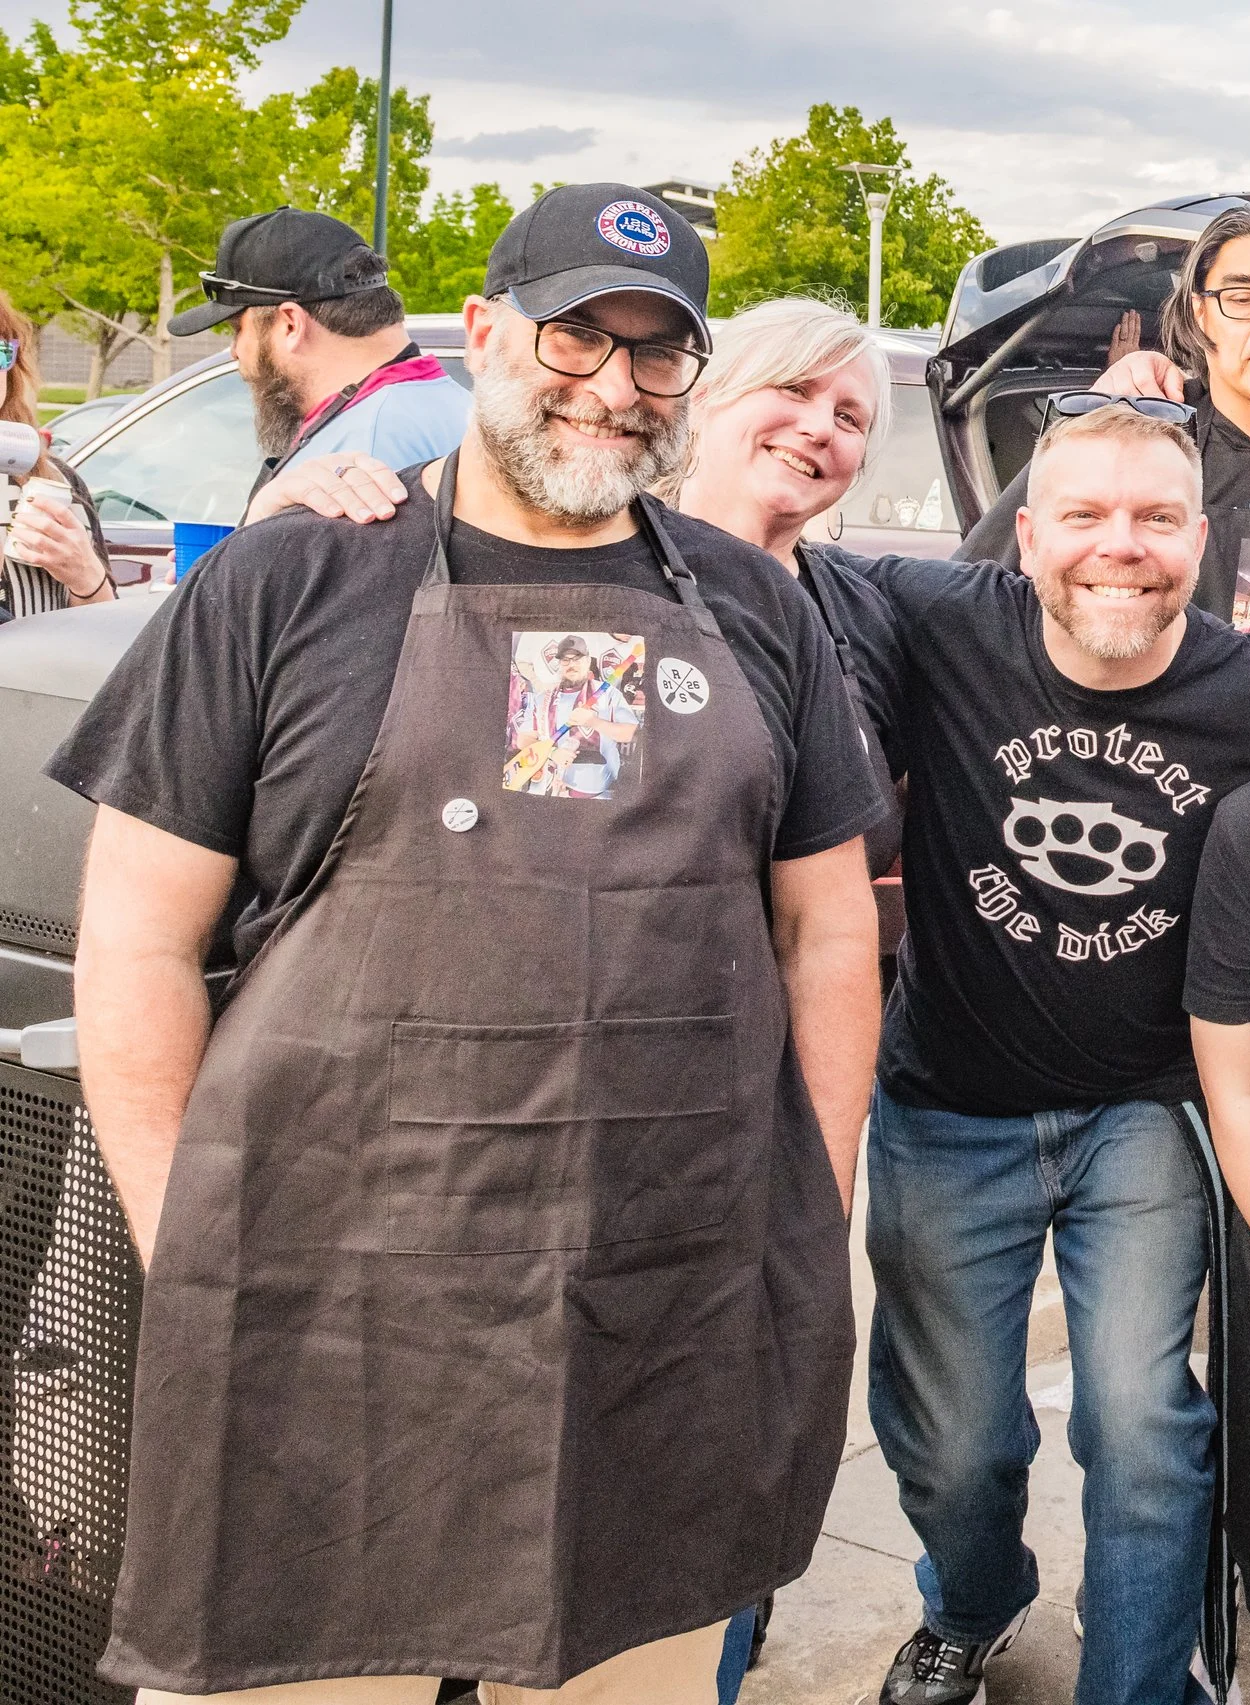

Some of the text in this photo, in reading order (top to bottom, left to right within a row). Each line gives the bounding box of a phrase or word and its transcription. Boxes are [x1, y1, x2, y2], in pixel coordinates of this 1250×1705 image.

[602, 202, 636, 220] WHITE
[636, 203, 661, 226] PASS
[619, 224, 654, 239] YEARS
[623, 217, 651, 231] 125
[602, 225, 667, 254] YUKON ROUTE
[672, 669, 681, 680] R
[663, 680, 700, 690] 81 26
[679, 692, 687, 703] S
[994, 722, 1212, 816] protect
[969, 863, 1180, 962] the dick
